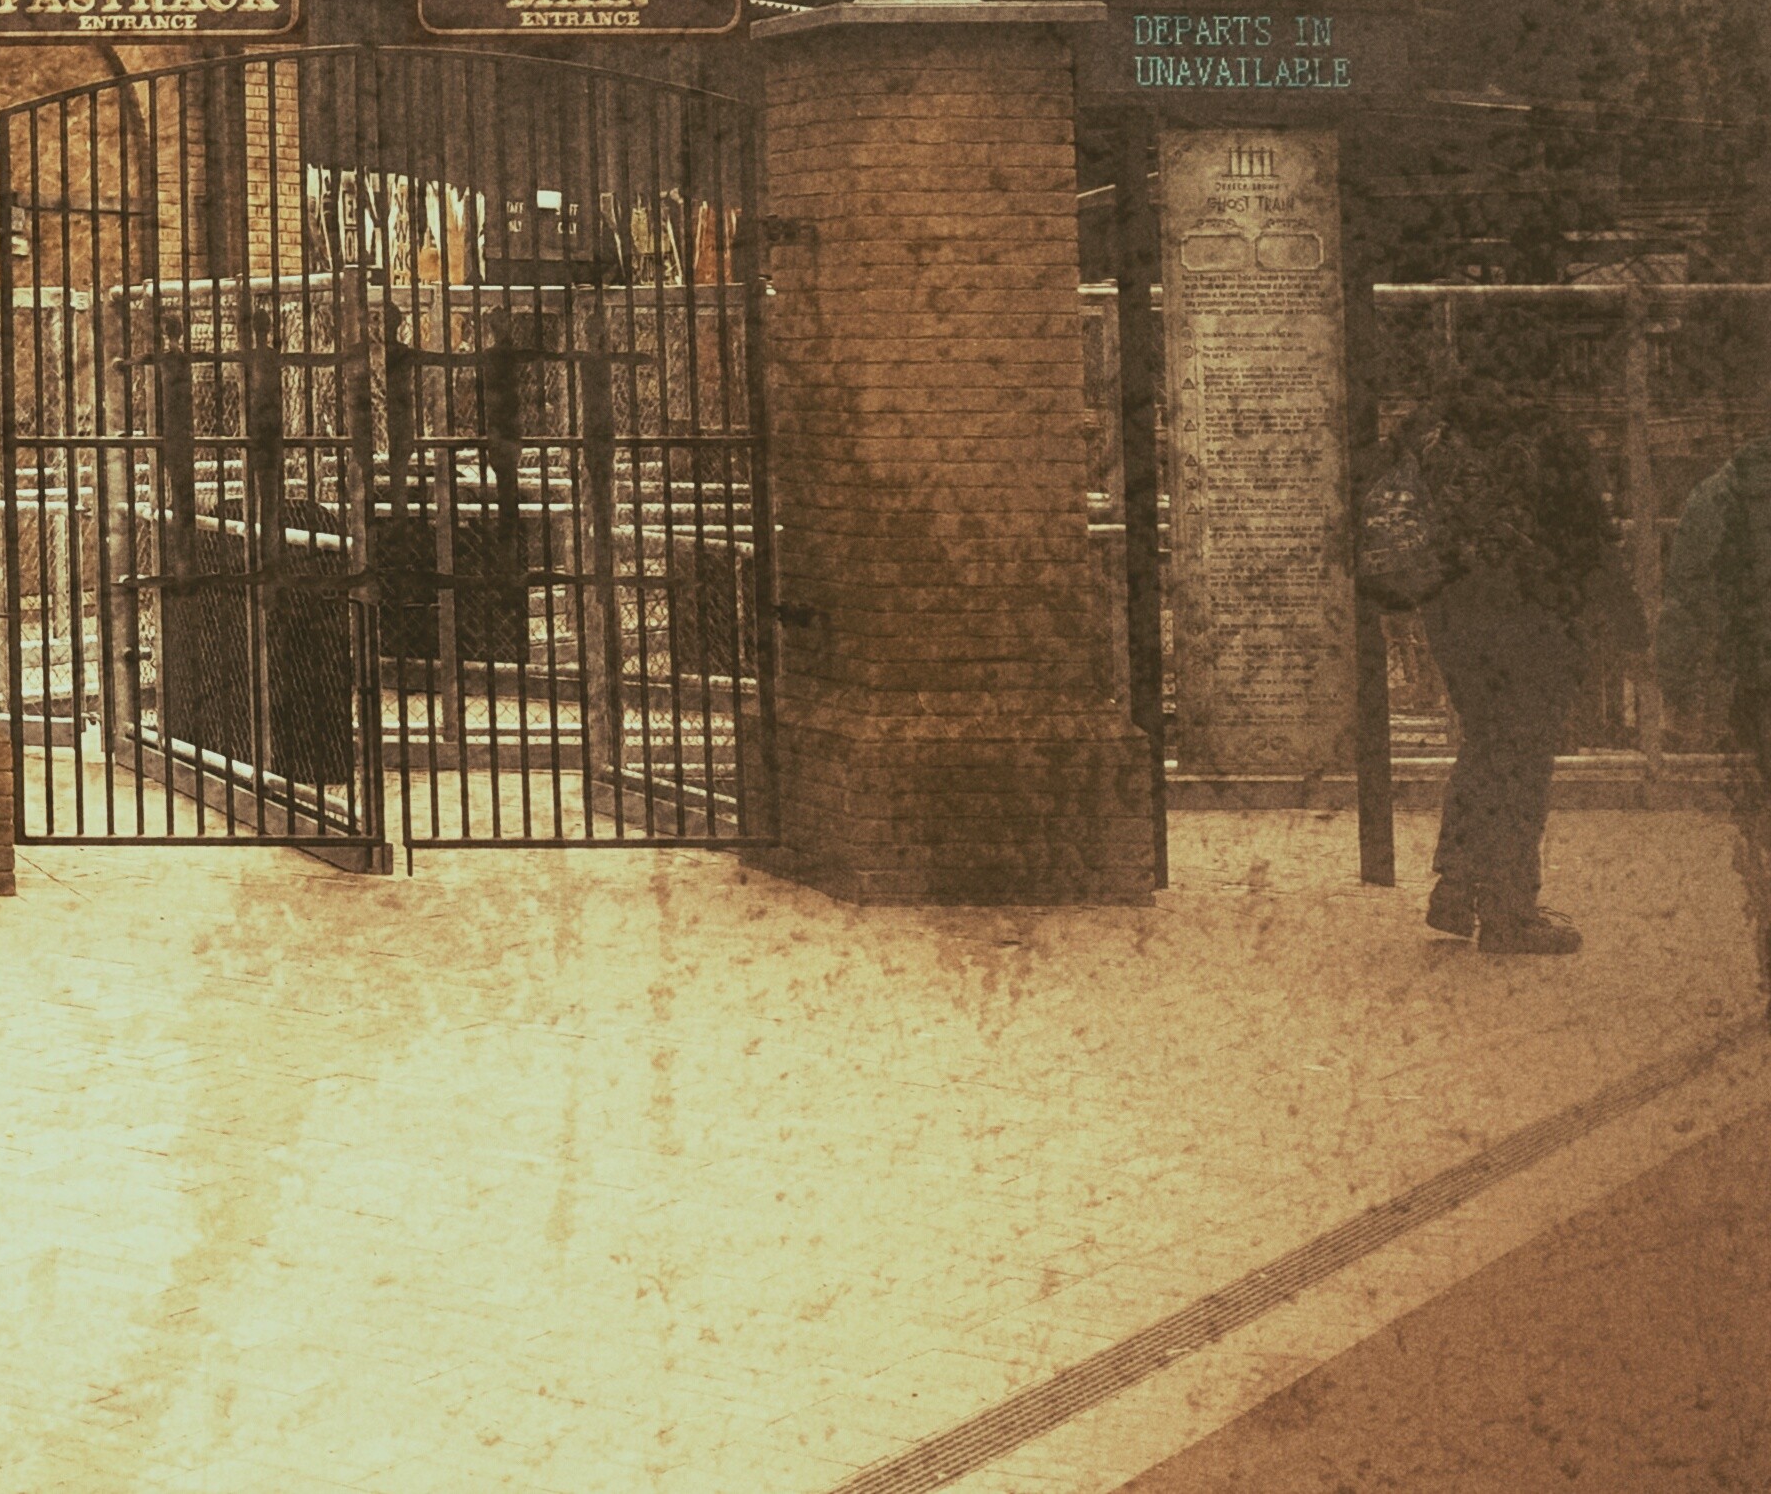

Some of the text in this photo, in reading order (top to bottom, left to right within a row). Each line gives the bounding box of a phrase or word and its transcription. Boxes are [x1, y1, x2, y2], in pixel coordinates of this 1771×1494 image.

[78, 14, 198, 31] ENTRANCE
[520, 11, 641, 27] ENTRANCE
[1133, 15, 1333, 46] DEPARTS IN
[1134, 56, 1352, 87] UNAVAILABLE
[1207, 196, 1294, 213] GHOST TRAIN
